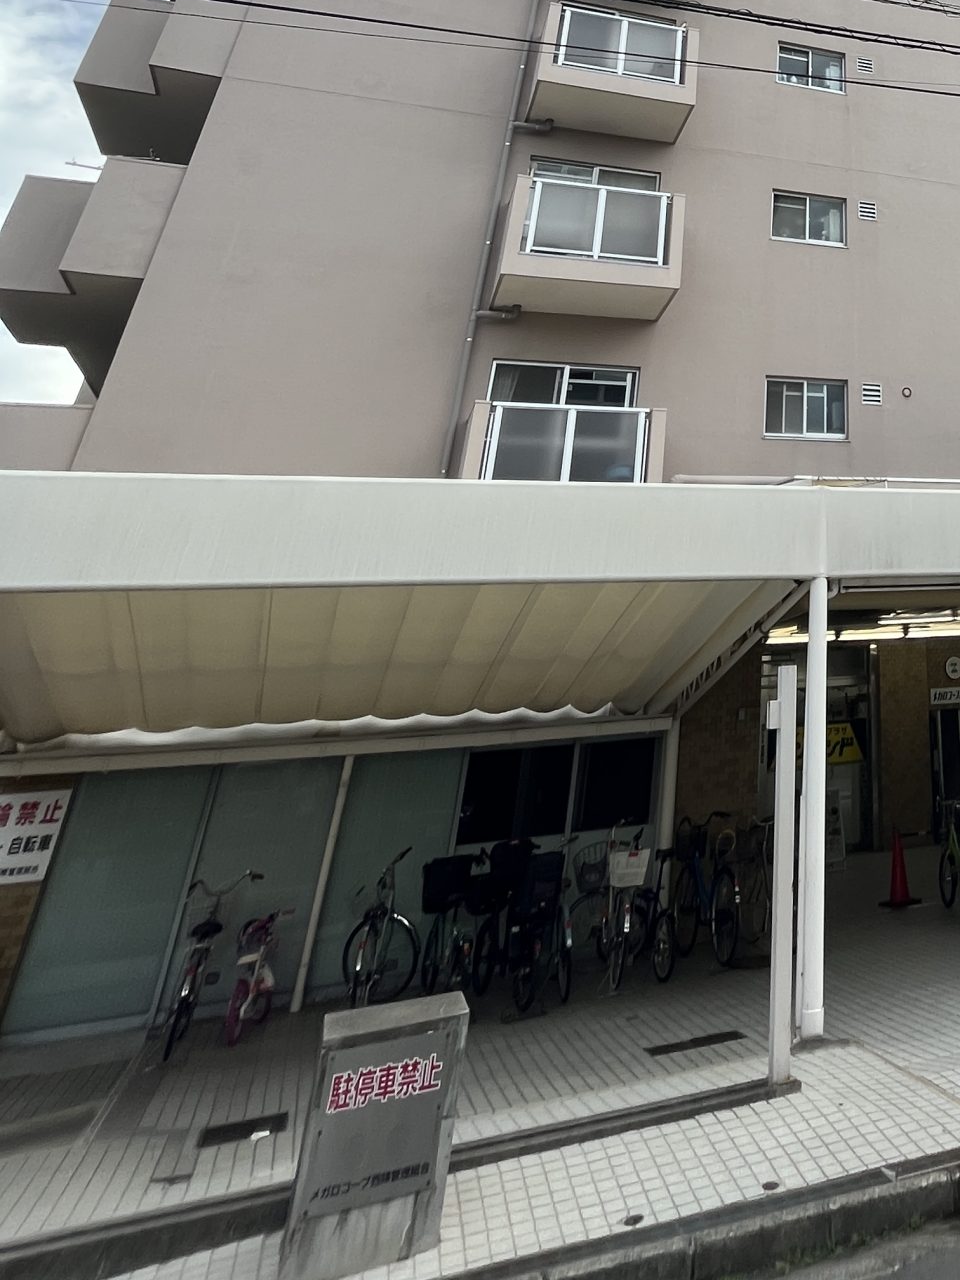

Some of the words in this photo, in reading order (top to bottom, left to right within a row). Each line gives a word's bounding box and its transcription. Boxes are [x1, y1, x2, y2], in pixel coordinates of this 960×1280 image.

[326, 1053, 443, 1114] 駐停車禁止
